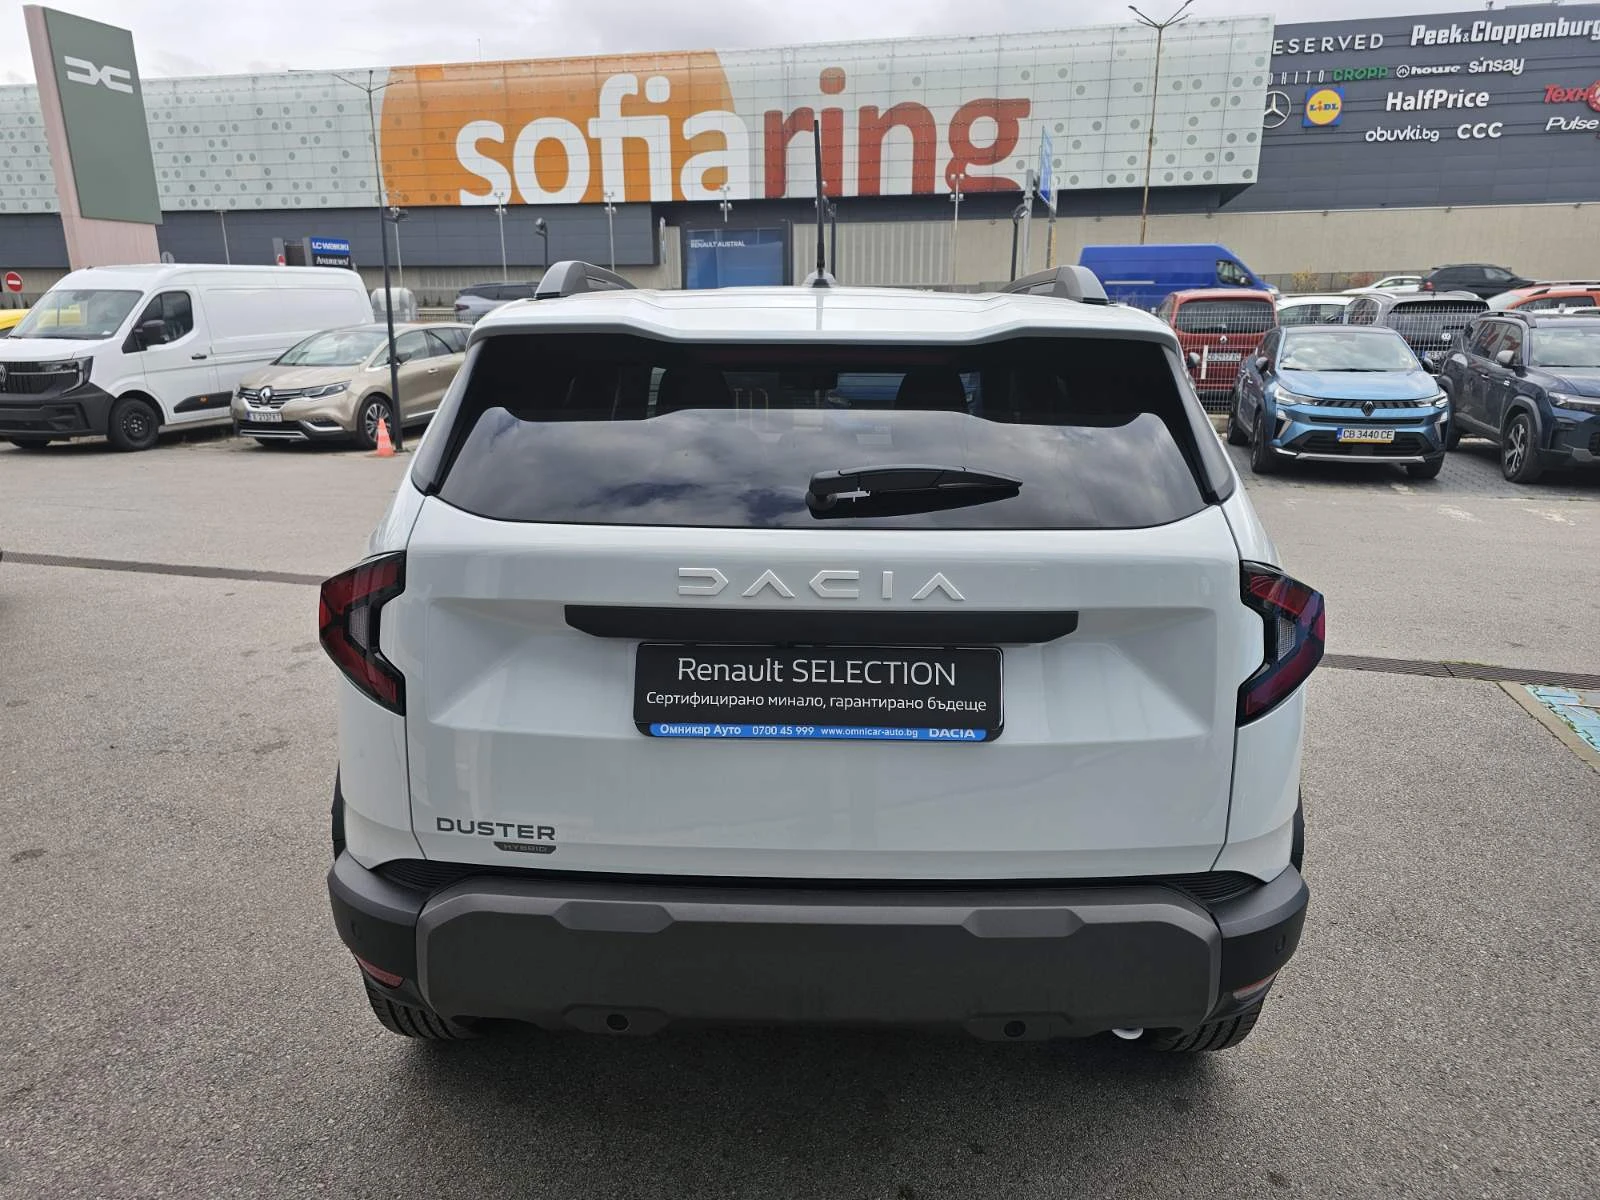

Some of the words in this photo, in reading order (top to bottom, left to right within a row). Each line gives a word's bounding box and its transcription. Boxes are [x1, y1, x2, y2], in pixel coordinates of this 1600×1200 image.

[1272, 34, 1384, 55] ESERVED
[1333, 66, 1389, 81] CROPP
[1468, 57, 1524, 75] sinsay
[1268, 70, 1324, 85] OHITO
[1385, 89, 1490, 111] HalfPrice
[1457, 122, 1503, 139] CCC
[1545, 116, 1600, 131] Pulse
[1365, 125, 1440, 142] obuvki.bg
[1357, 430, 1379, 439] 3440
[678, 567, 966, 601] DACIA
[677, 657, 784, 683] Renault
[792, 659, 956, 687] SELECTION
[646, 691, 765, 708] Сертифицирано
[768, 696, 827, 708] минало,
[830, 697, 924, 712] гарантирано
[928, 697, 987, 712] бъдеще
[660, 724, 710, 737] Омникар
[714, 724, 742, 736] Ауто
[752, 726, 776, 736] 0700
[779, 726, 793, 736] 45
[795, 726, 815, 736] 999
[820, 727, 918, 738] www.omnicar-auto.bg
[929, 728, 976, 739] DACIA
[436, 817, 556, 841] DUSTER
[503, 843, 549, 853] HYBRID
